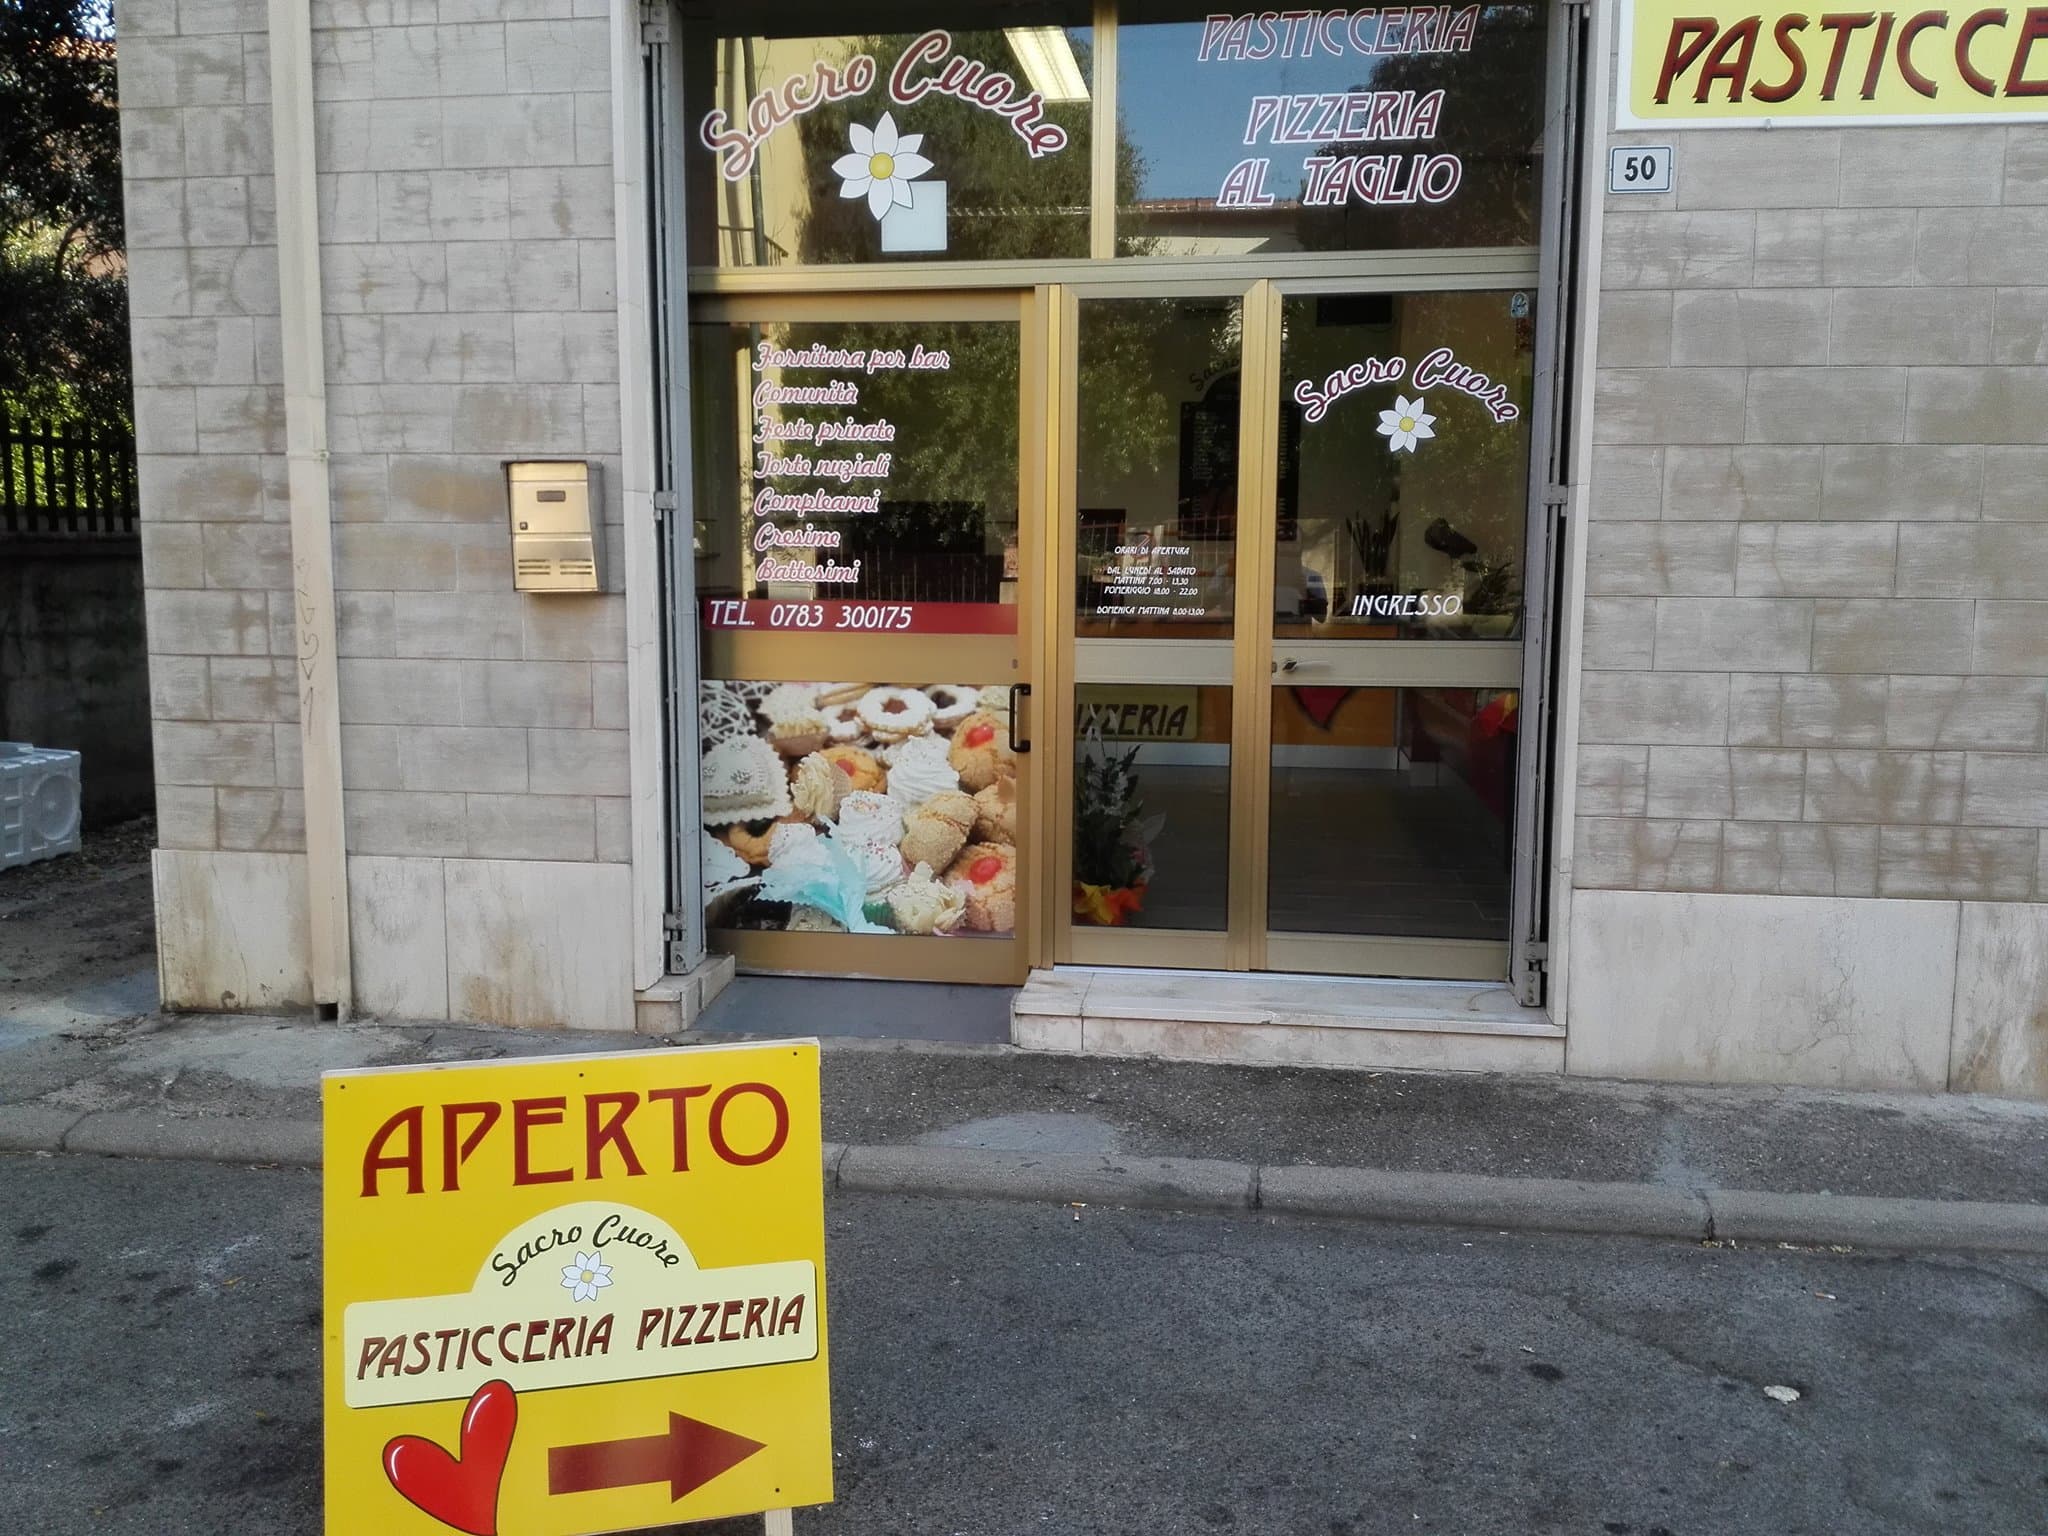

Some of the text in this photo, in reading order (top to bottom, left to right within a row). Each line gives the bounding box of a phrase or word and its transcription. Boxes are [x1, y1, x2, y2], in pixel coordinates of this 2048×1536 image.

[1198, 4, 1481, 61] PASTICCERIA
[701, 29, 1068, 182] Sacro Cuore
[1243, 89, 1446, 144] PIZZERIA
[1216, 154, 1462, 207] AL TAGLIO
[1623, 154, 1657, 182] 50
[753, 343, 950, 374] Fornitura per bar
[754, 380, 858, 408] Comunità
[1295, 347, 1519, 424] Sacro Cuore
[754, 416, 895, 446] Feste private
[754, 451, 891, 482] Torte nuziali
[754, 486, 881, 517] Compleanni
[754, 522, 840, 551] Cresime
[756, 559, 861, 583] Battesimi
[710, 600, 913, 629] TEL. 0783 300175
[1351, 594, 1462, 616] INGRESSO
[360, 1082, 789, 1197] APERTO
[491, 1214, 680, 1287] Sacro Cuore
[357, 1294, 806, 1381] PASTICCERIA PIZZERIA
